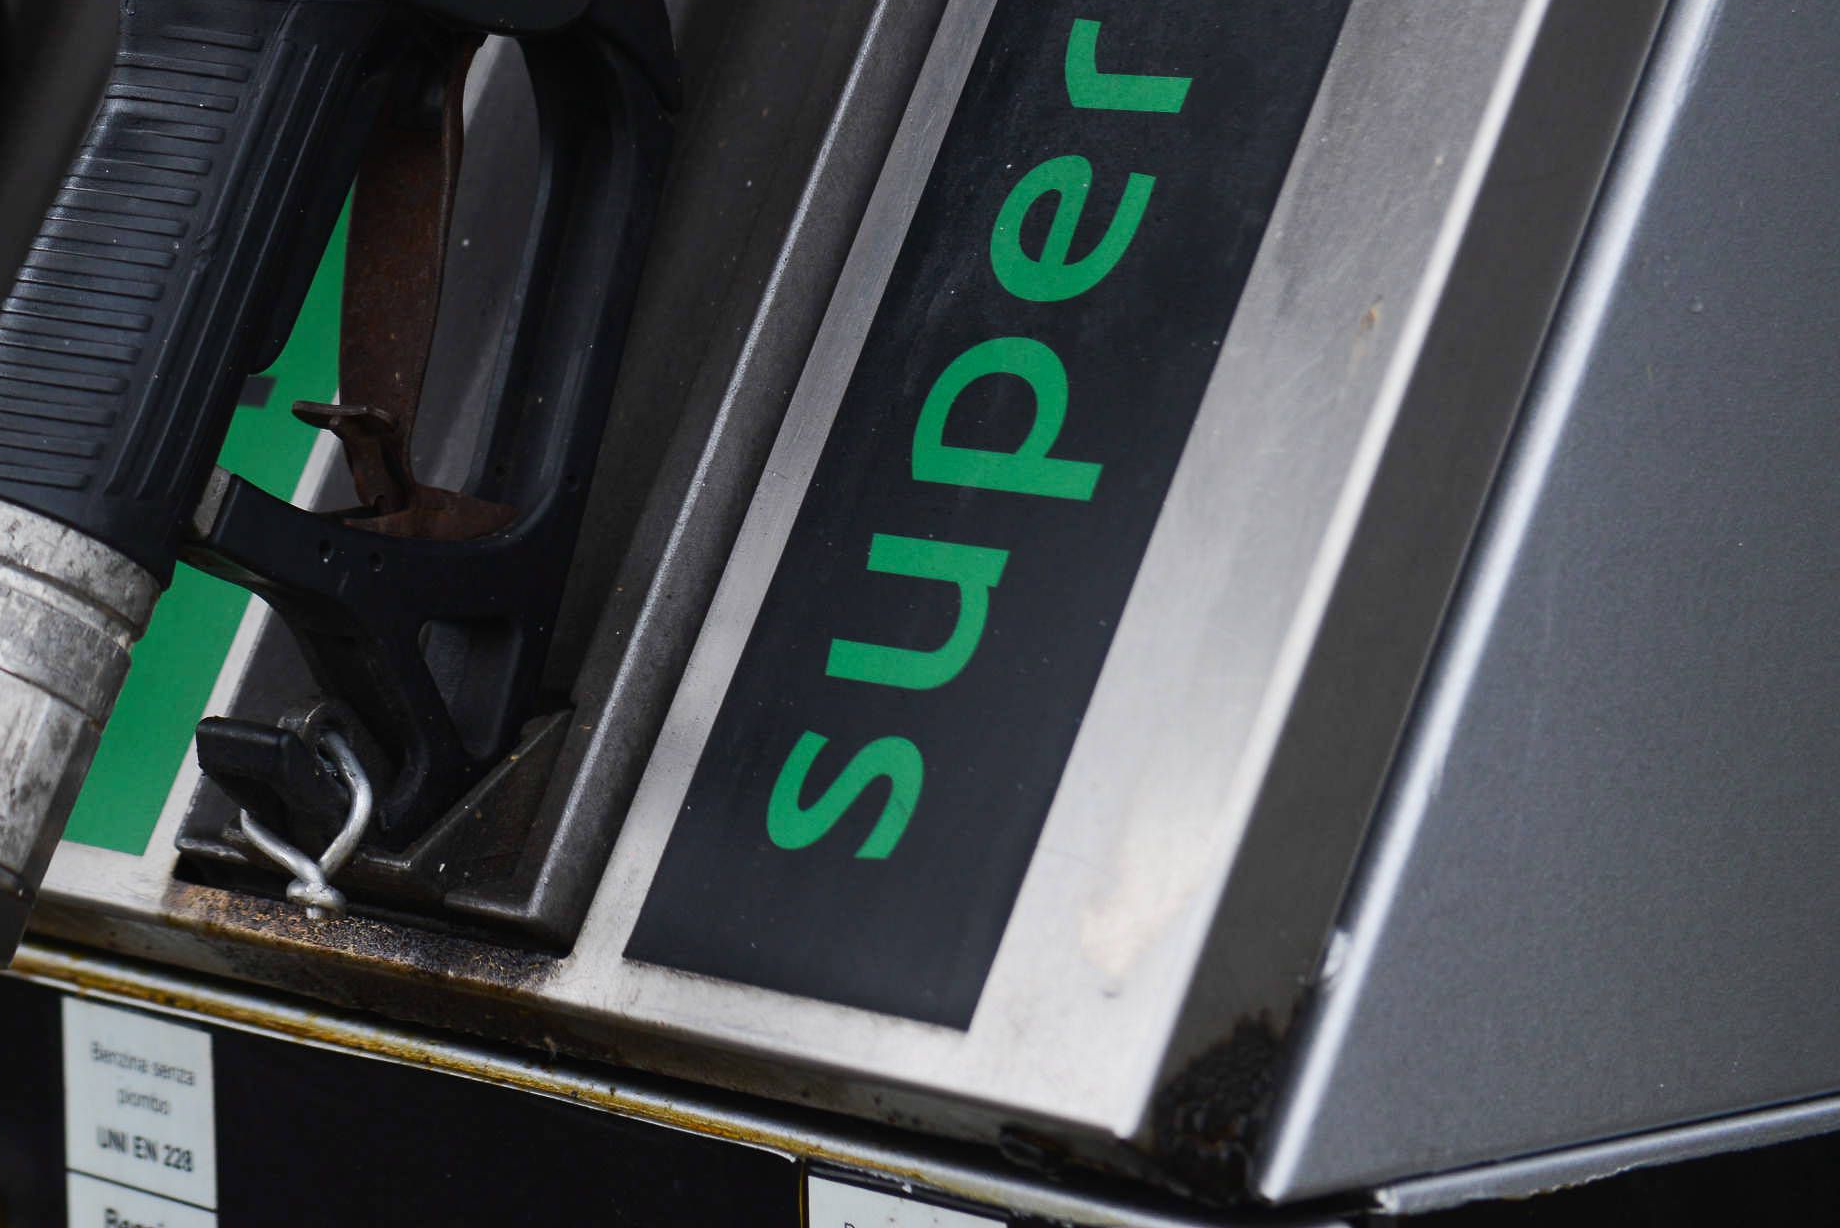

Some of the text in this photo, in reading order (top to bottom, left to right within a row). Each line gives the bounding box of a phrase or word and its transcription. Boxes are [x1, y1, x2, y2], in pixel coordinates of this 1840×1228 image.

[766, 18, 1193, 860] super
[97, 1125, 129, 1154] UNI
[133, 1136, 158, 1163] EN
